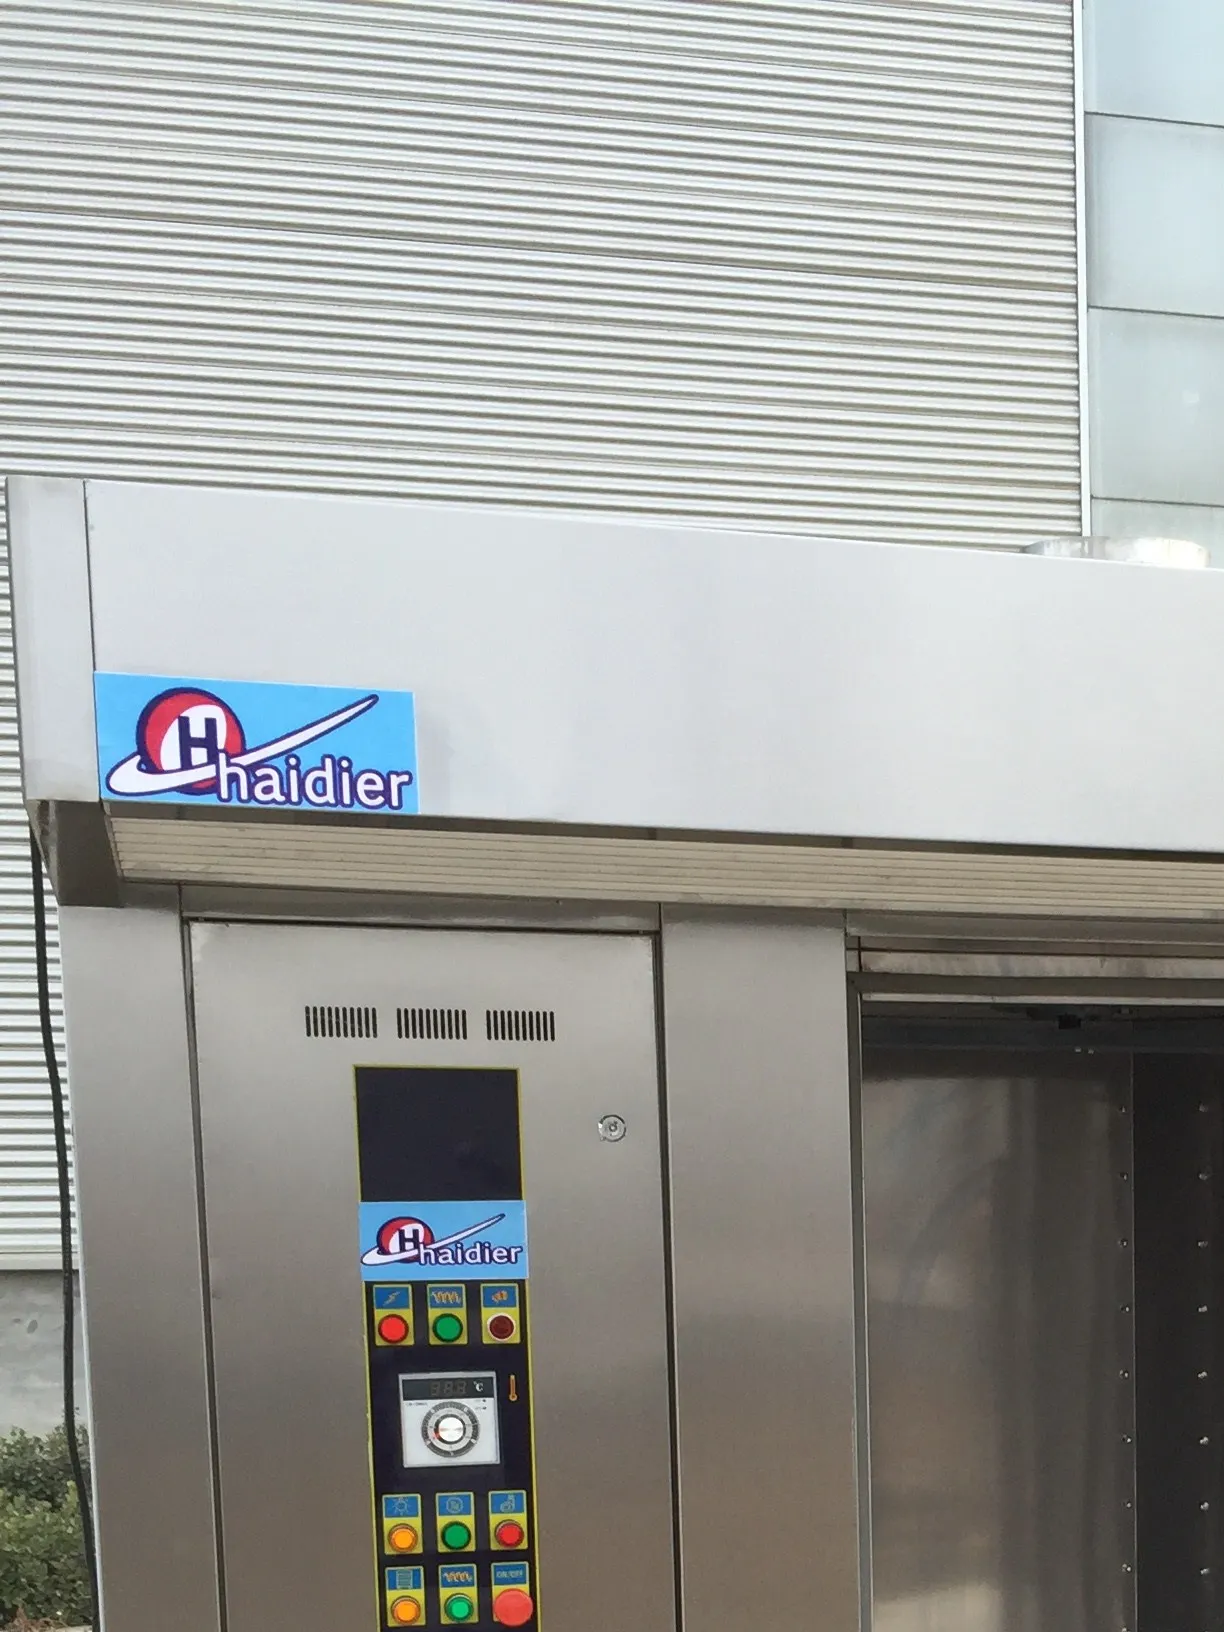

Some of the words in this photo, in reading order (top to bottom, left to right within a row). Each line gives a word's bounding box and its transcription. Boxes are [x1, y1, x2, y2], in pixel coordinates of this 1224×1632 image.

[178, 715, 219, 771] H
[216, 748, 413, 810] haidier
[419, 1241, 523, 1266] haidier
